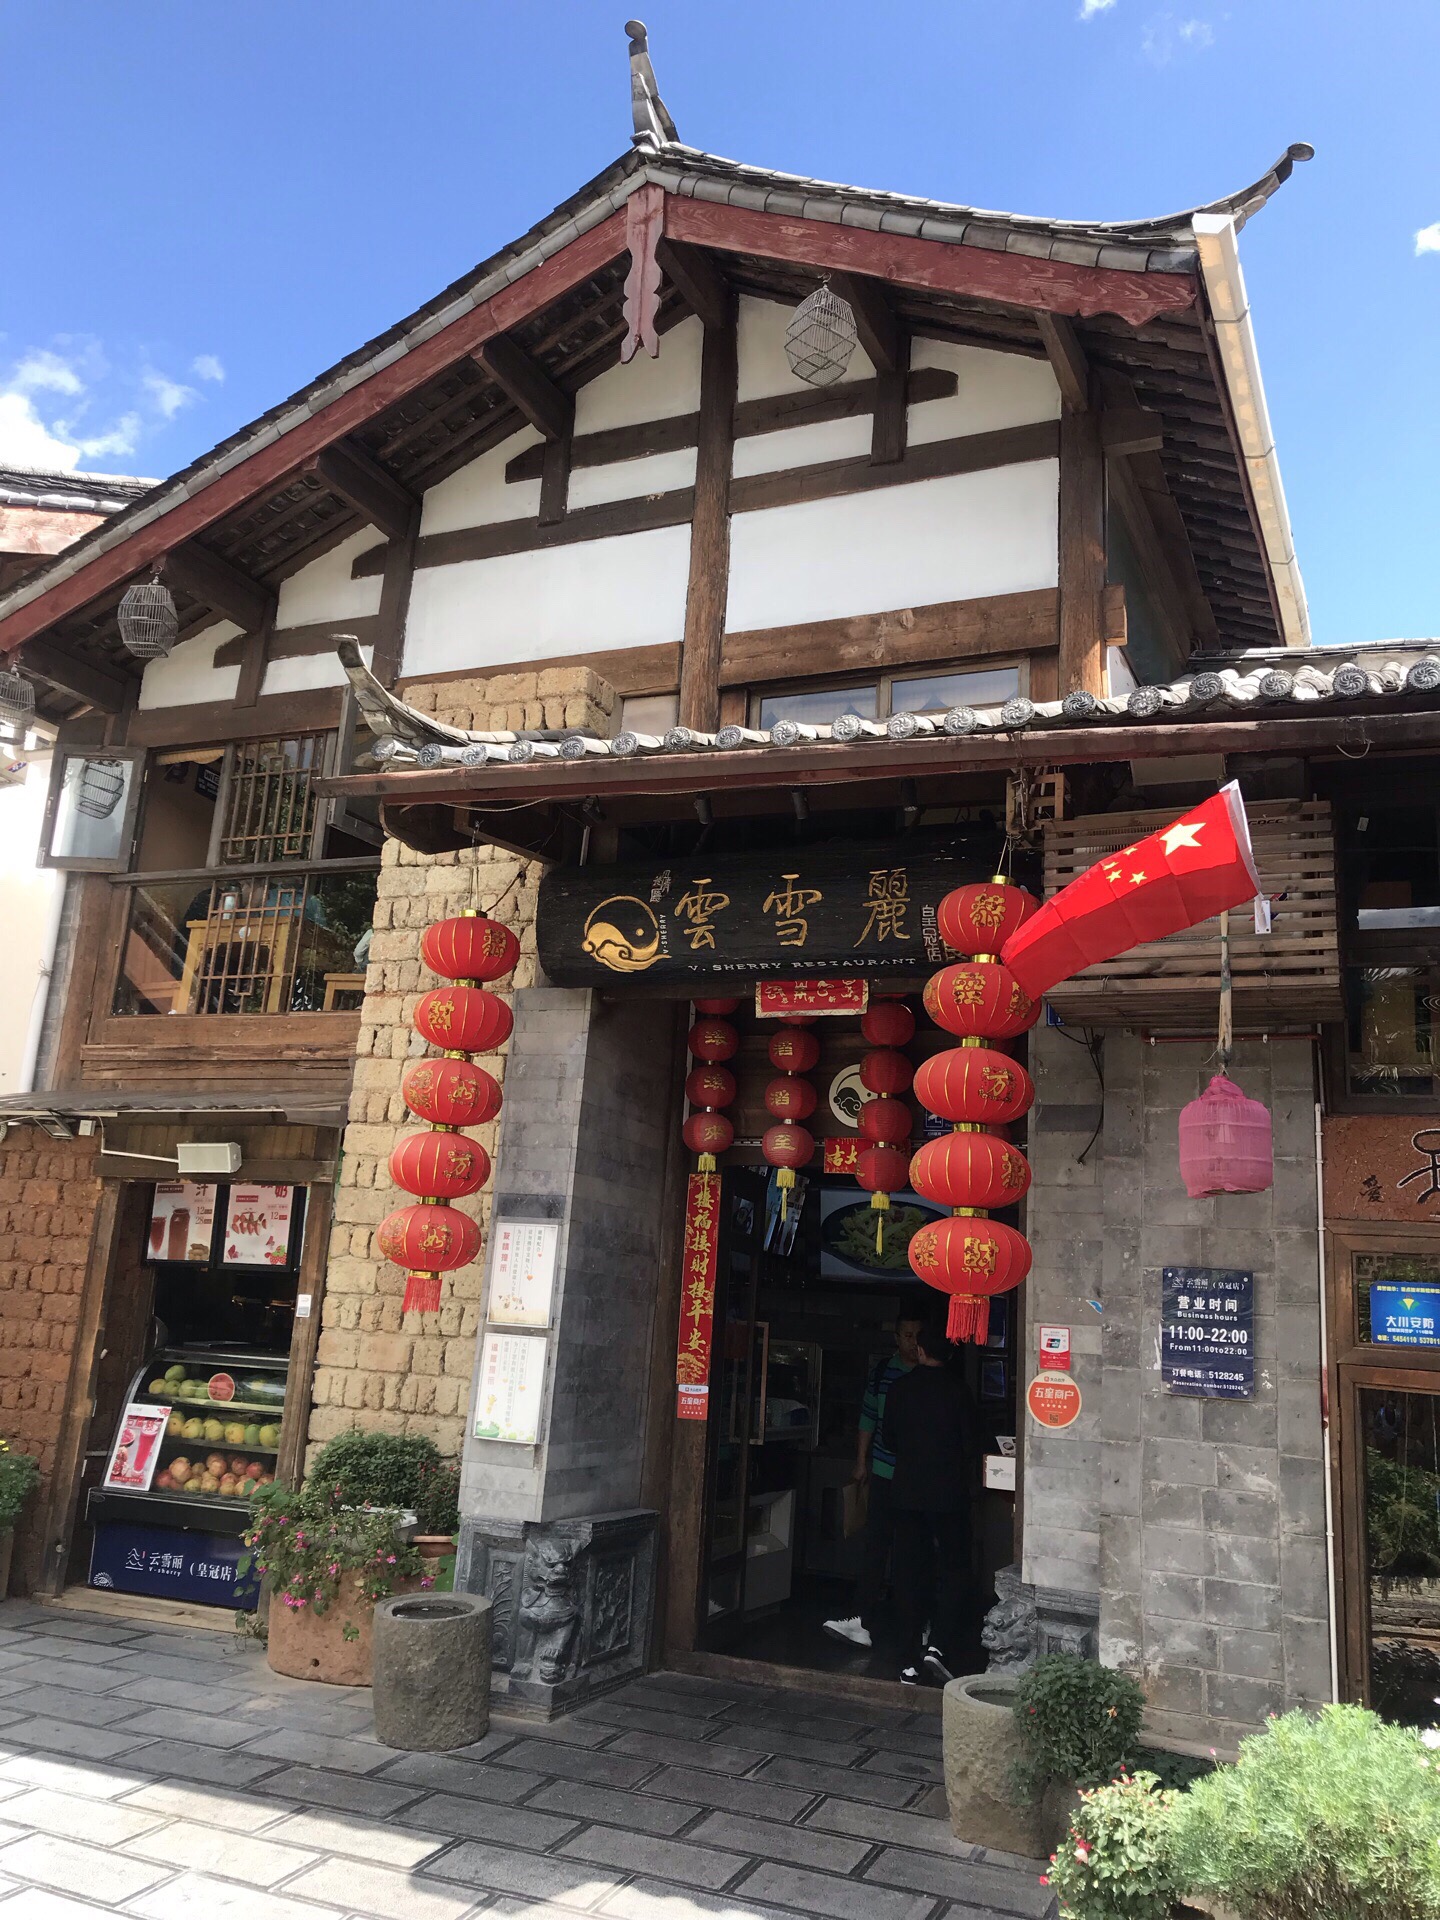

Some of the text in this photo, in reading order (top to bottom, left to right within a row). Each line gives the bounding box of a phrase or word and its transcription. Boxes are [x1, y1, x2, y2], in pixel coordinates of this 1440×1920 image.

[674, 868, 911, 950] 雲雪麗
[921, 904, 942, 963] 皇冠店
[712, 961, 782, 971] SHERRY
[791, 958, 917, 968] RESTAURANT
[1177, 1295, 1238, 1313] 营业时间
[1177, 1311, 1238, 1321] Business hours
[1385, 1315, 1435, 1329] 大川安防
[1169, 1325, 1248, 1344] 11:00-22:00
[1034, 1386, 1075, 1400] 五星商户
[681, 1396, 706, 1406] 五星商户
[149, 1552, 184, 1569] 云雪丽
